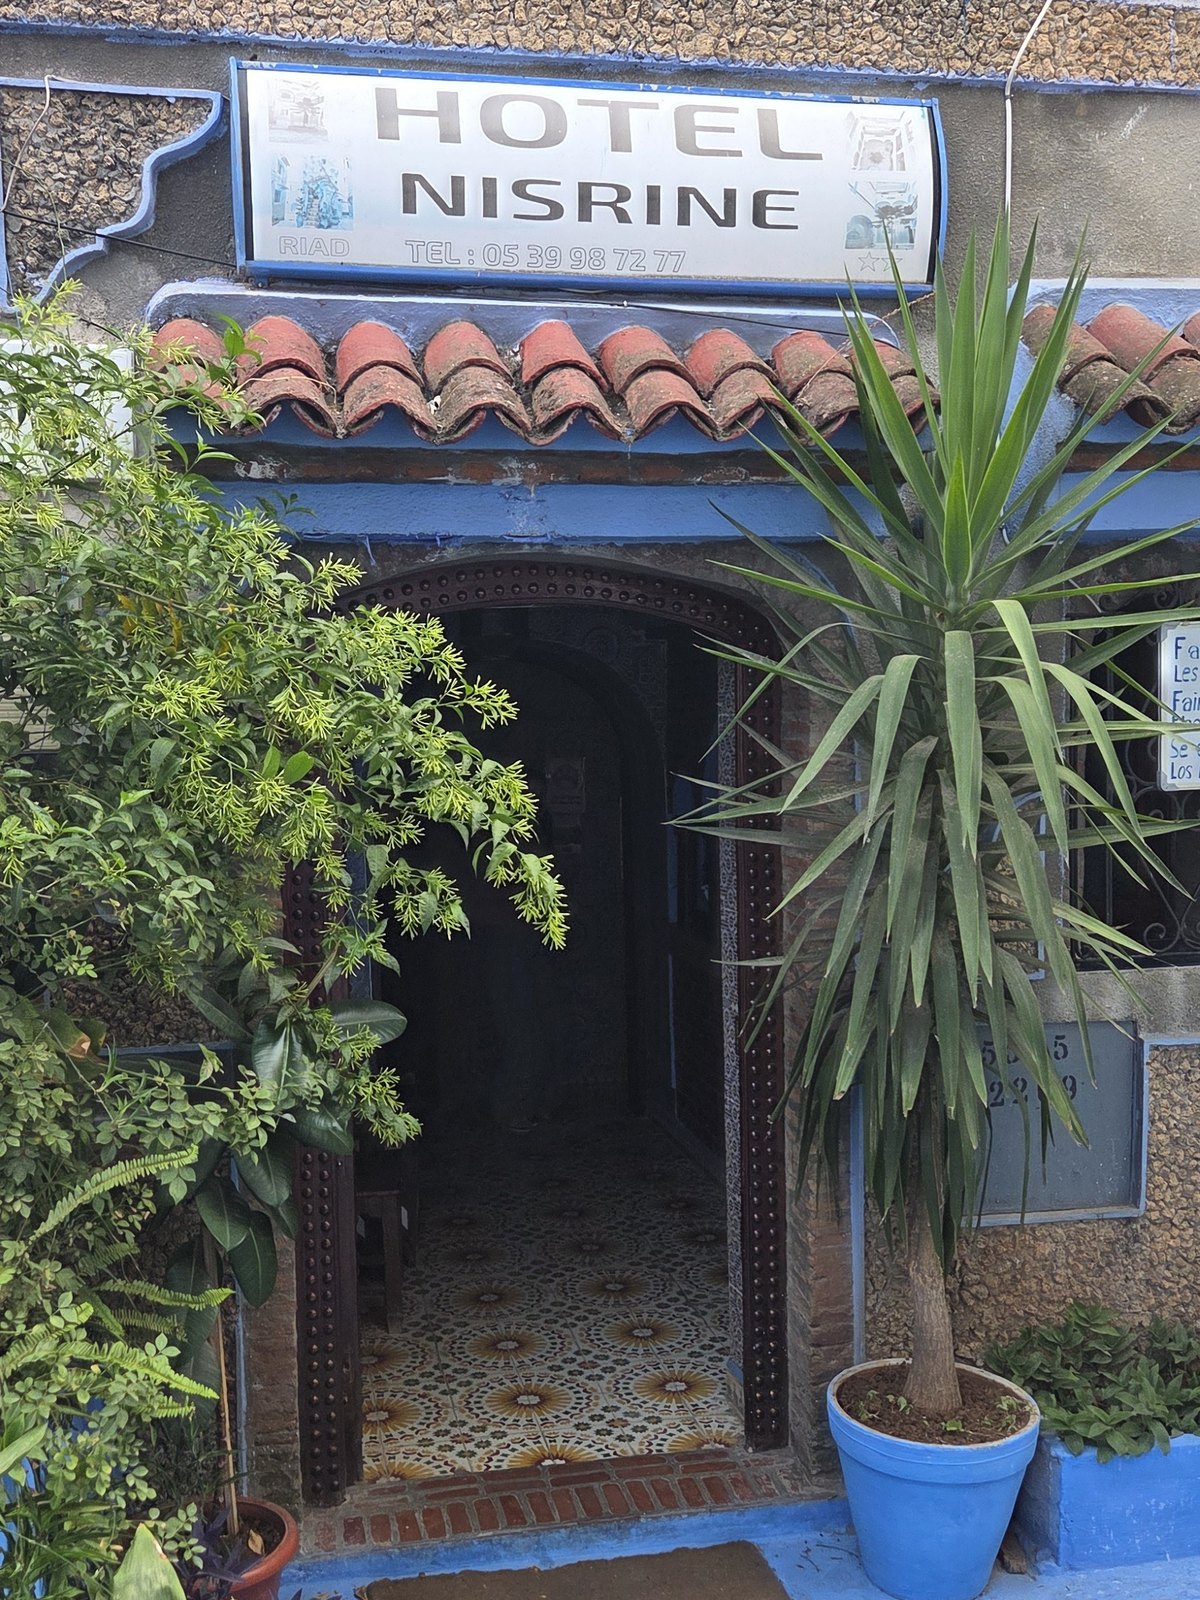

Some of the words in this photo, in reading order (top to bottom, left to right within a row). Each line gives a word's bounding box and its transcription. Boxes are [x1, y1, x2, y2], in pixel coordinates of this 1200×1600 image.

[375, 87, 823, 161] HOTEL
[402, 173, 799, 230] NISRINE
[279, 235, 350, 257] RIAD
[482, 243, 519, 268] 05
[527, 244, 562, 269] 39
[570, 246, 606, 271] 98
[613, 248, 646, 272] 72
[653, 250, 686, 273] 77
[1174, 664, 1199, 683] Les
